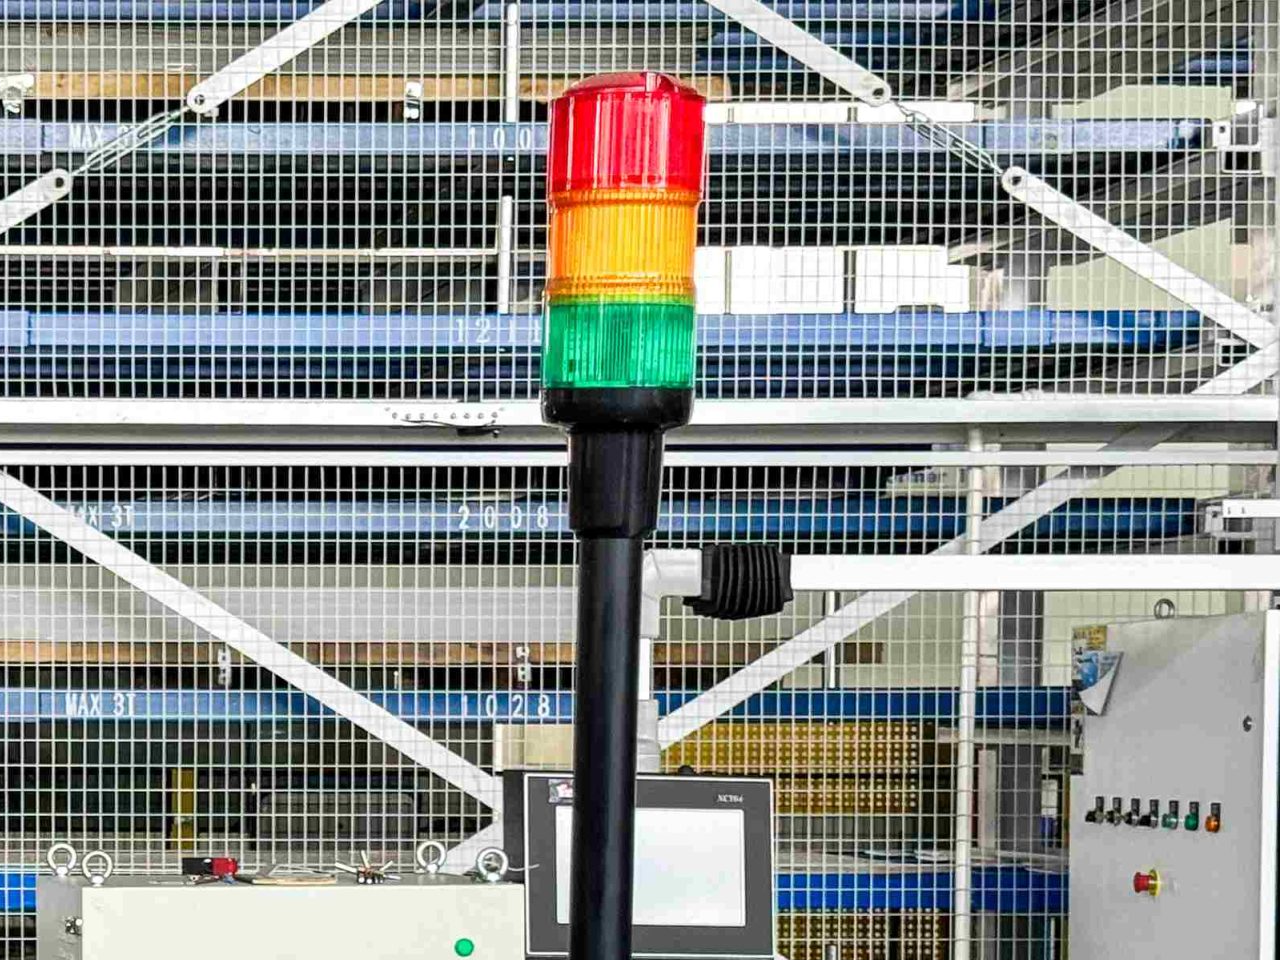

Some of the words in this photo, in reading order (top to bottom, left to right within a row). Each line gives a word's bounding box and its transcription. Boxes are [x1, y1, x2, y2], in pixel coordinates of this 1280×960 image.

[111, 505, 134, 527] 3T
[458, 506, 548, 529] 2008
[65, 693, 101, 717] MAX
[113, 693, 136, 717] 3T
[462, 694, 550, 717] 1028
